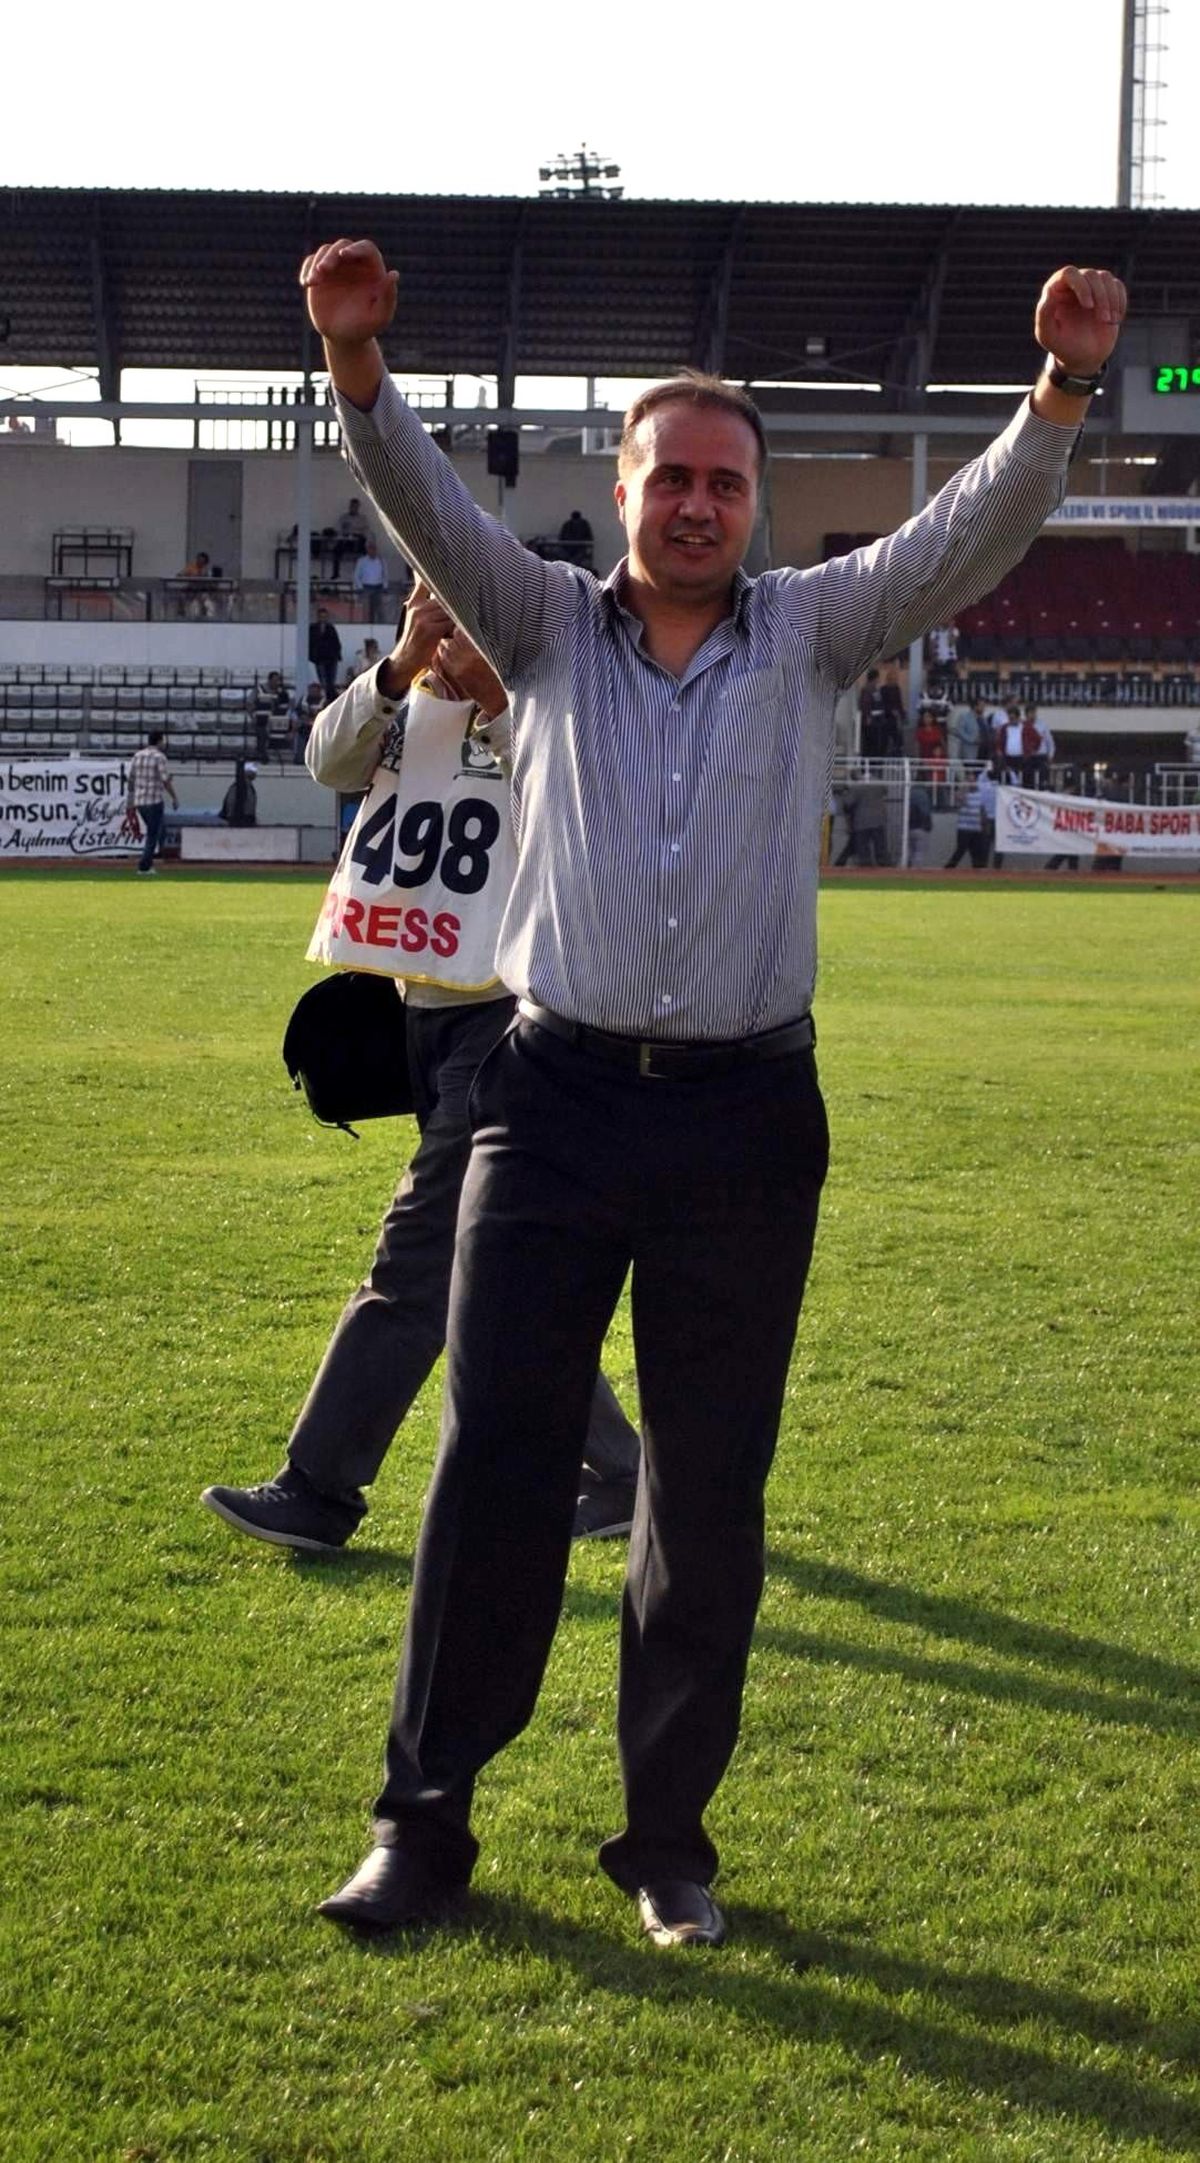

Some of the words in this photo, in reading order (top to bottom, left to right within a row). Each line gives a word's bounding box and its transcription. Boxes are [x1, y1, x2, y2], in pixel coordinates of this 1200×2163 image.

[1109, 504, 1140, 519] SPOR
[9, 765, 68, 792] benim
[1105, 811, 1144, 834] BABA
[1150, 812, 1190, 836] SPOR
[351, 792, 500, 894] 498
[328, 891, 461, 958] PRESS
